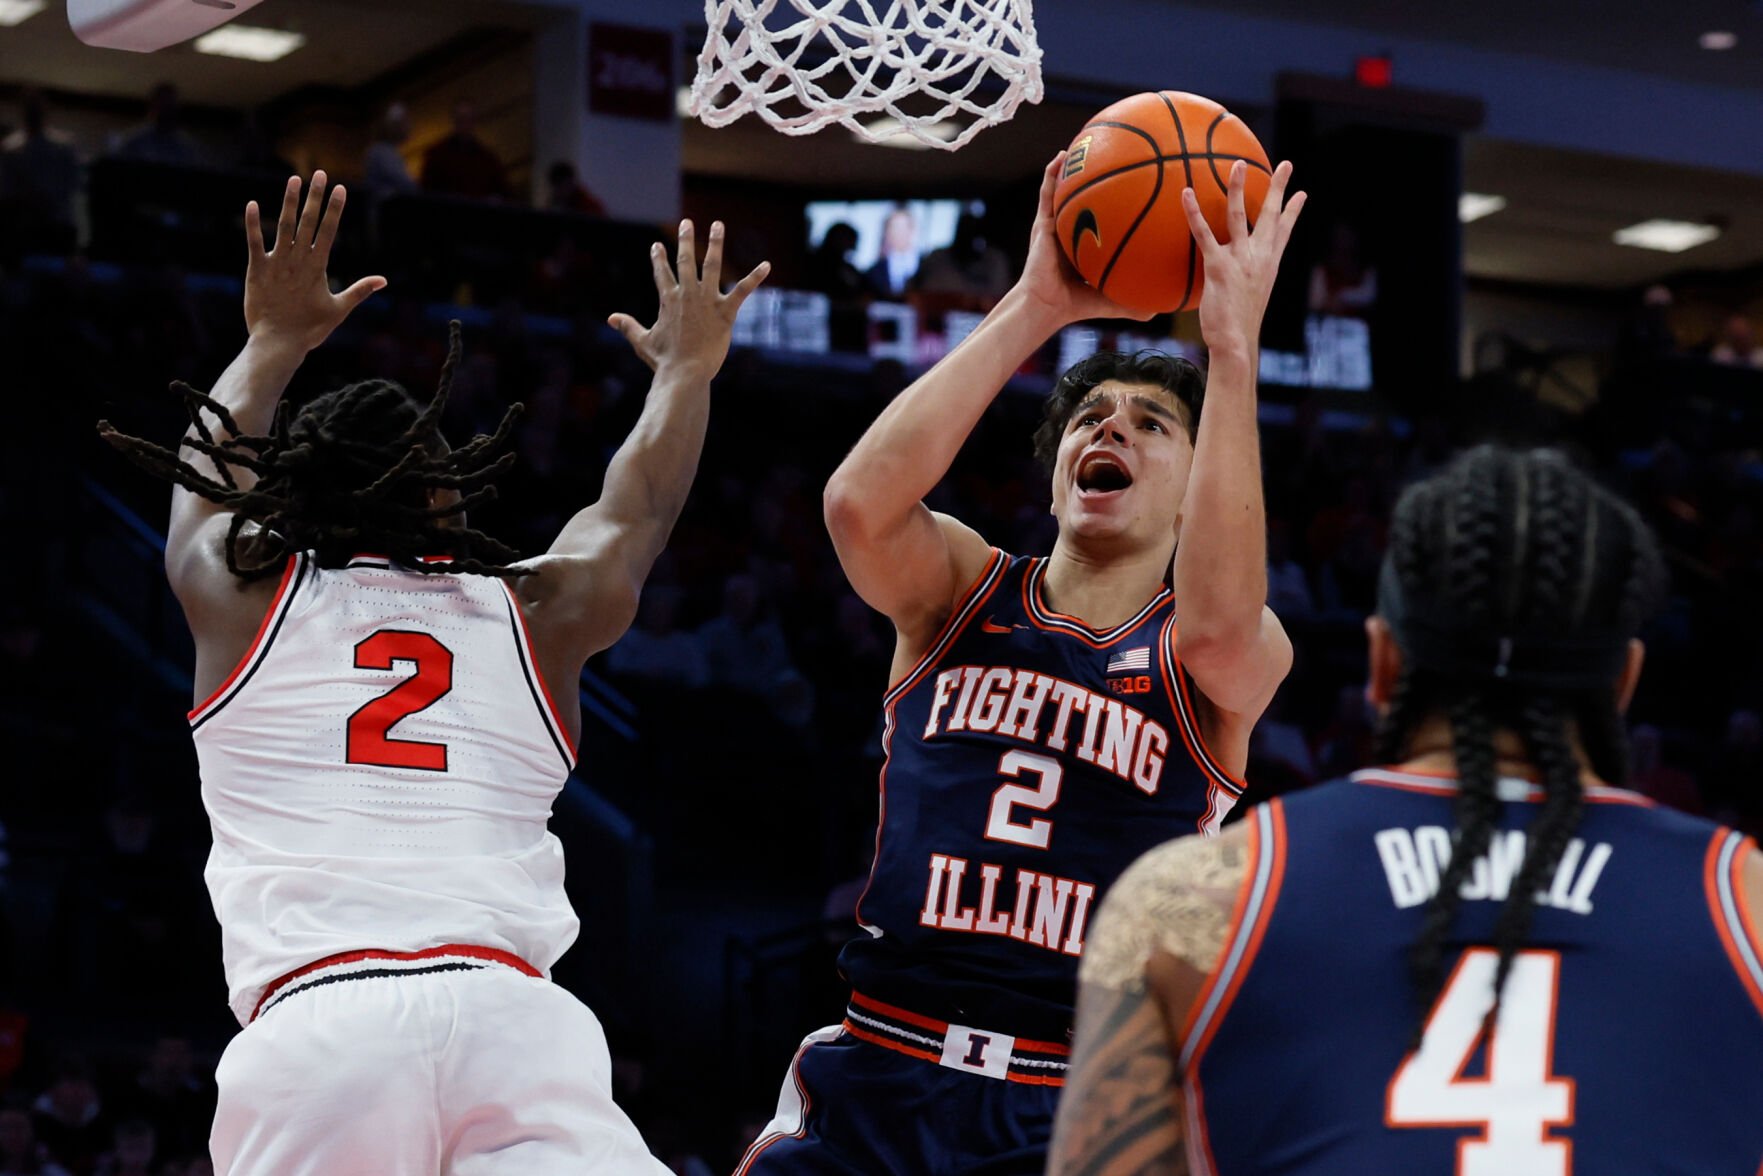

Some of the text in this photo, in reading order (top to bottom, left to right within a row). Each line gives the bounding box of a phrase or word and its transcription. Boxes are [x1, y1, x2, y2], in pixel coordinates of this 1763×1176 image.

[346, 629, 453, 772] 2
[922, 666, 1170, 795] FIGHTING
[984, 748, 1063, 850] 2
[919, 853, 1095, 956] ILLINI
[962, 1032, 992, 1068] I
[1384, 946, 1577, 1176] 4
